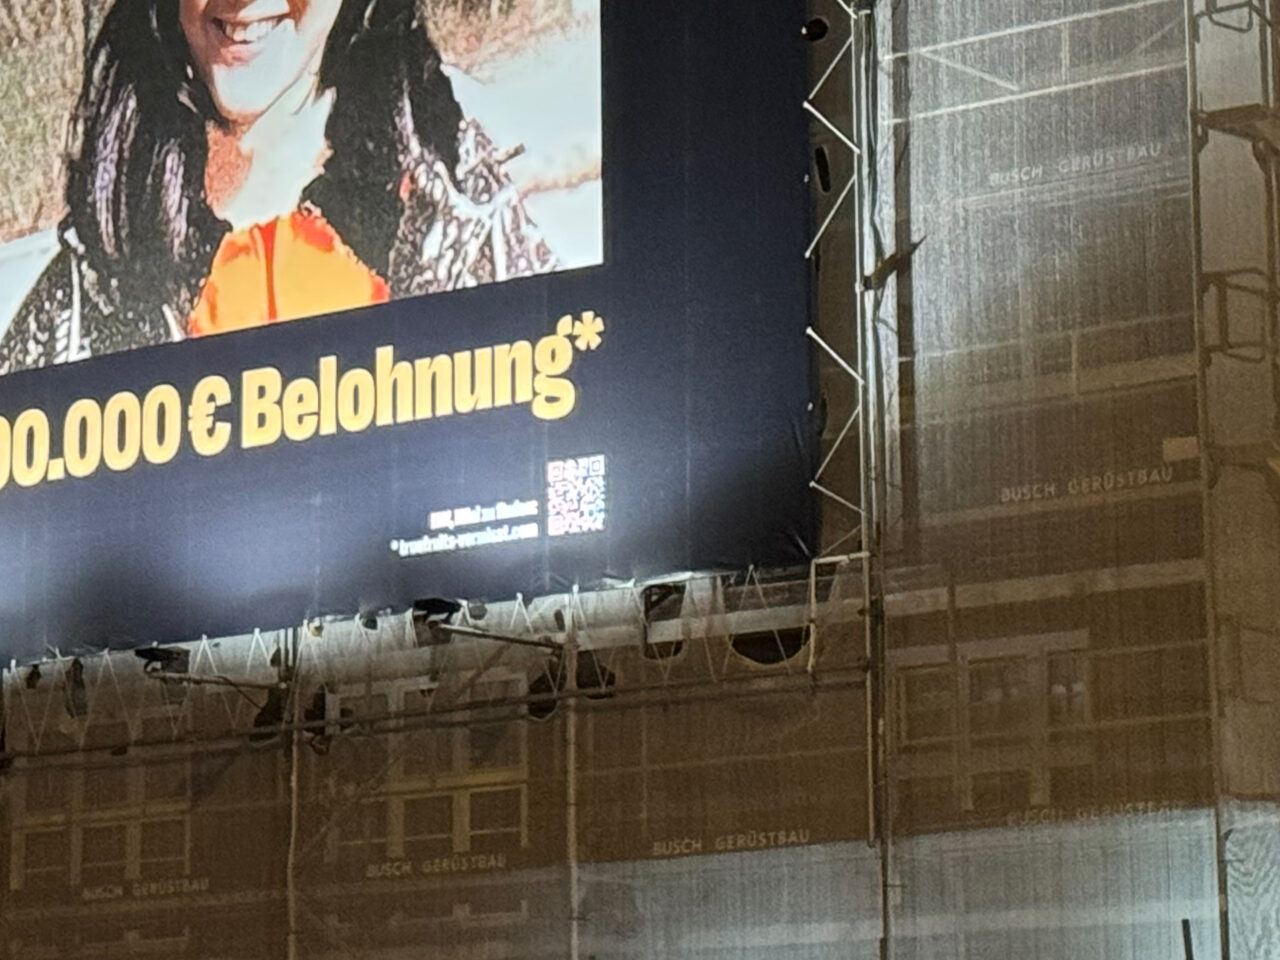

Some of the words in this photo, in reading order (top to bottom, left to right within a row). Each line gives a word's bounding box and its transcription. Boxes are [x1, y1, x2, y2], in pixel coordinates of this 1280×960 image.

[189, 377, 231, 456] €
[1000, 483, 1055, 503] BUSCH
[653, 839, 702, 857] BUSCH
[715, 828, 810, 850] GERÜSTBAU
